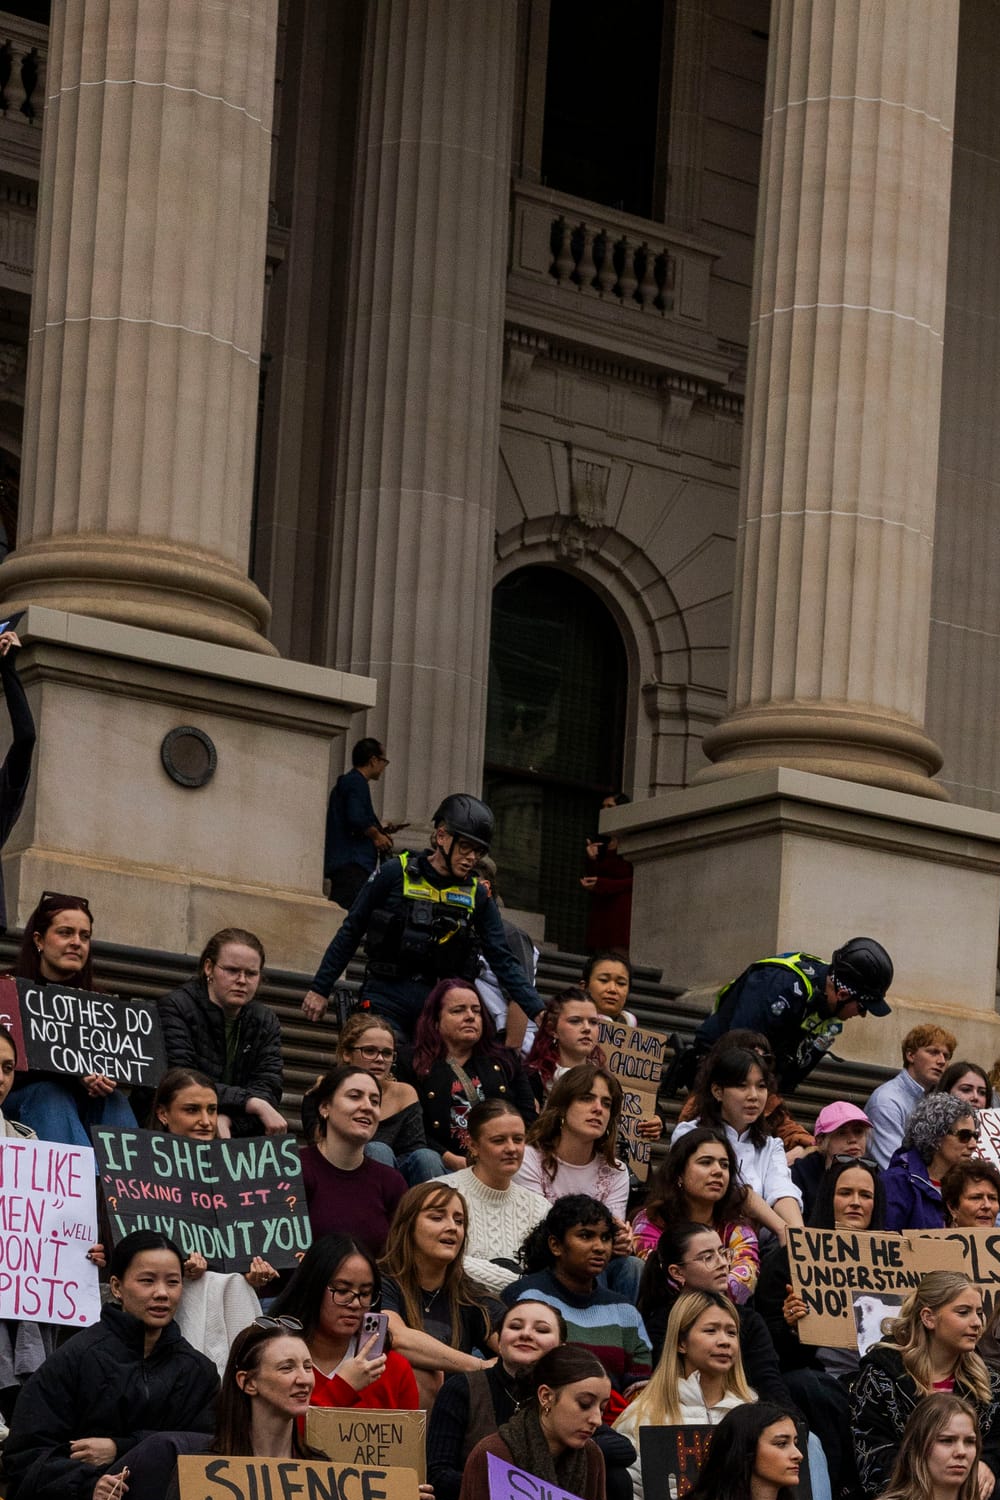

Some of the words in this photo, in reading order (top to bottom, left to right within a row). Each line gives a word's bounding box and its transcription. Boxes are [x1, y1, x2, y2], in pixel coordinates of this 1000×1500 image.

[26, 989, 114, 1029] CLOTHES
[125, 1007, 152, 1035] DO
[31, 1018, 72, 1045] NOT
[80, 1027, 153, 1060] EQUAL
[628, 1031, 666, 1058] AWAY
[50, 1046, 150, 1083] CONSENT
[609, 1051, 664, 1082] CHOICE
[32, 1147, 81, 1198] LIKE
[98, 1132, 138, 1171] IF
[151, 1136, 219, 1183] SHE
[221, 1138, 301, 1182] WAS
[191, 1191, 228, 1210] FOR
[0, 1235, 68, 1276] ON'T
[179, 1219, 254, 1259] DIDN'T
[262, 1215, 313, 1254] YOU
[788, 1228, 860, 1263] EVEN
[870, 1237, 904, 1268] HE
[800, 1288, 848, 1318] NO!
[339, 1423, 403, 1444] WOMEN
[354, 1445, 390, 1467] ARE
